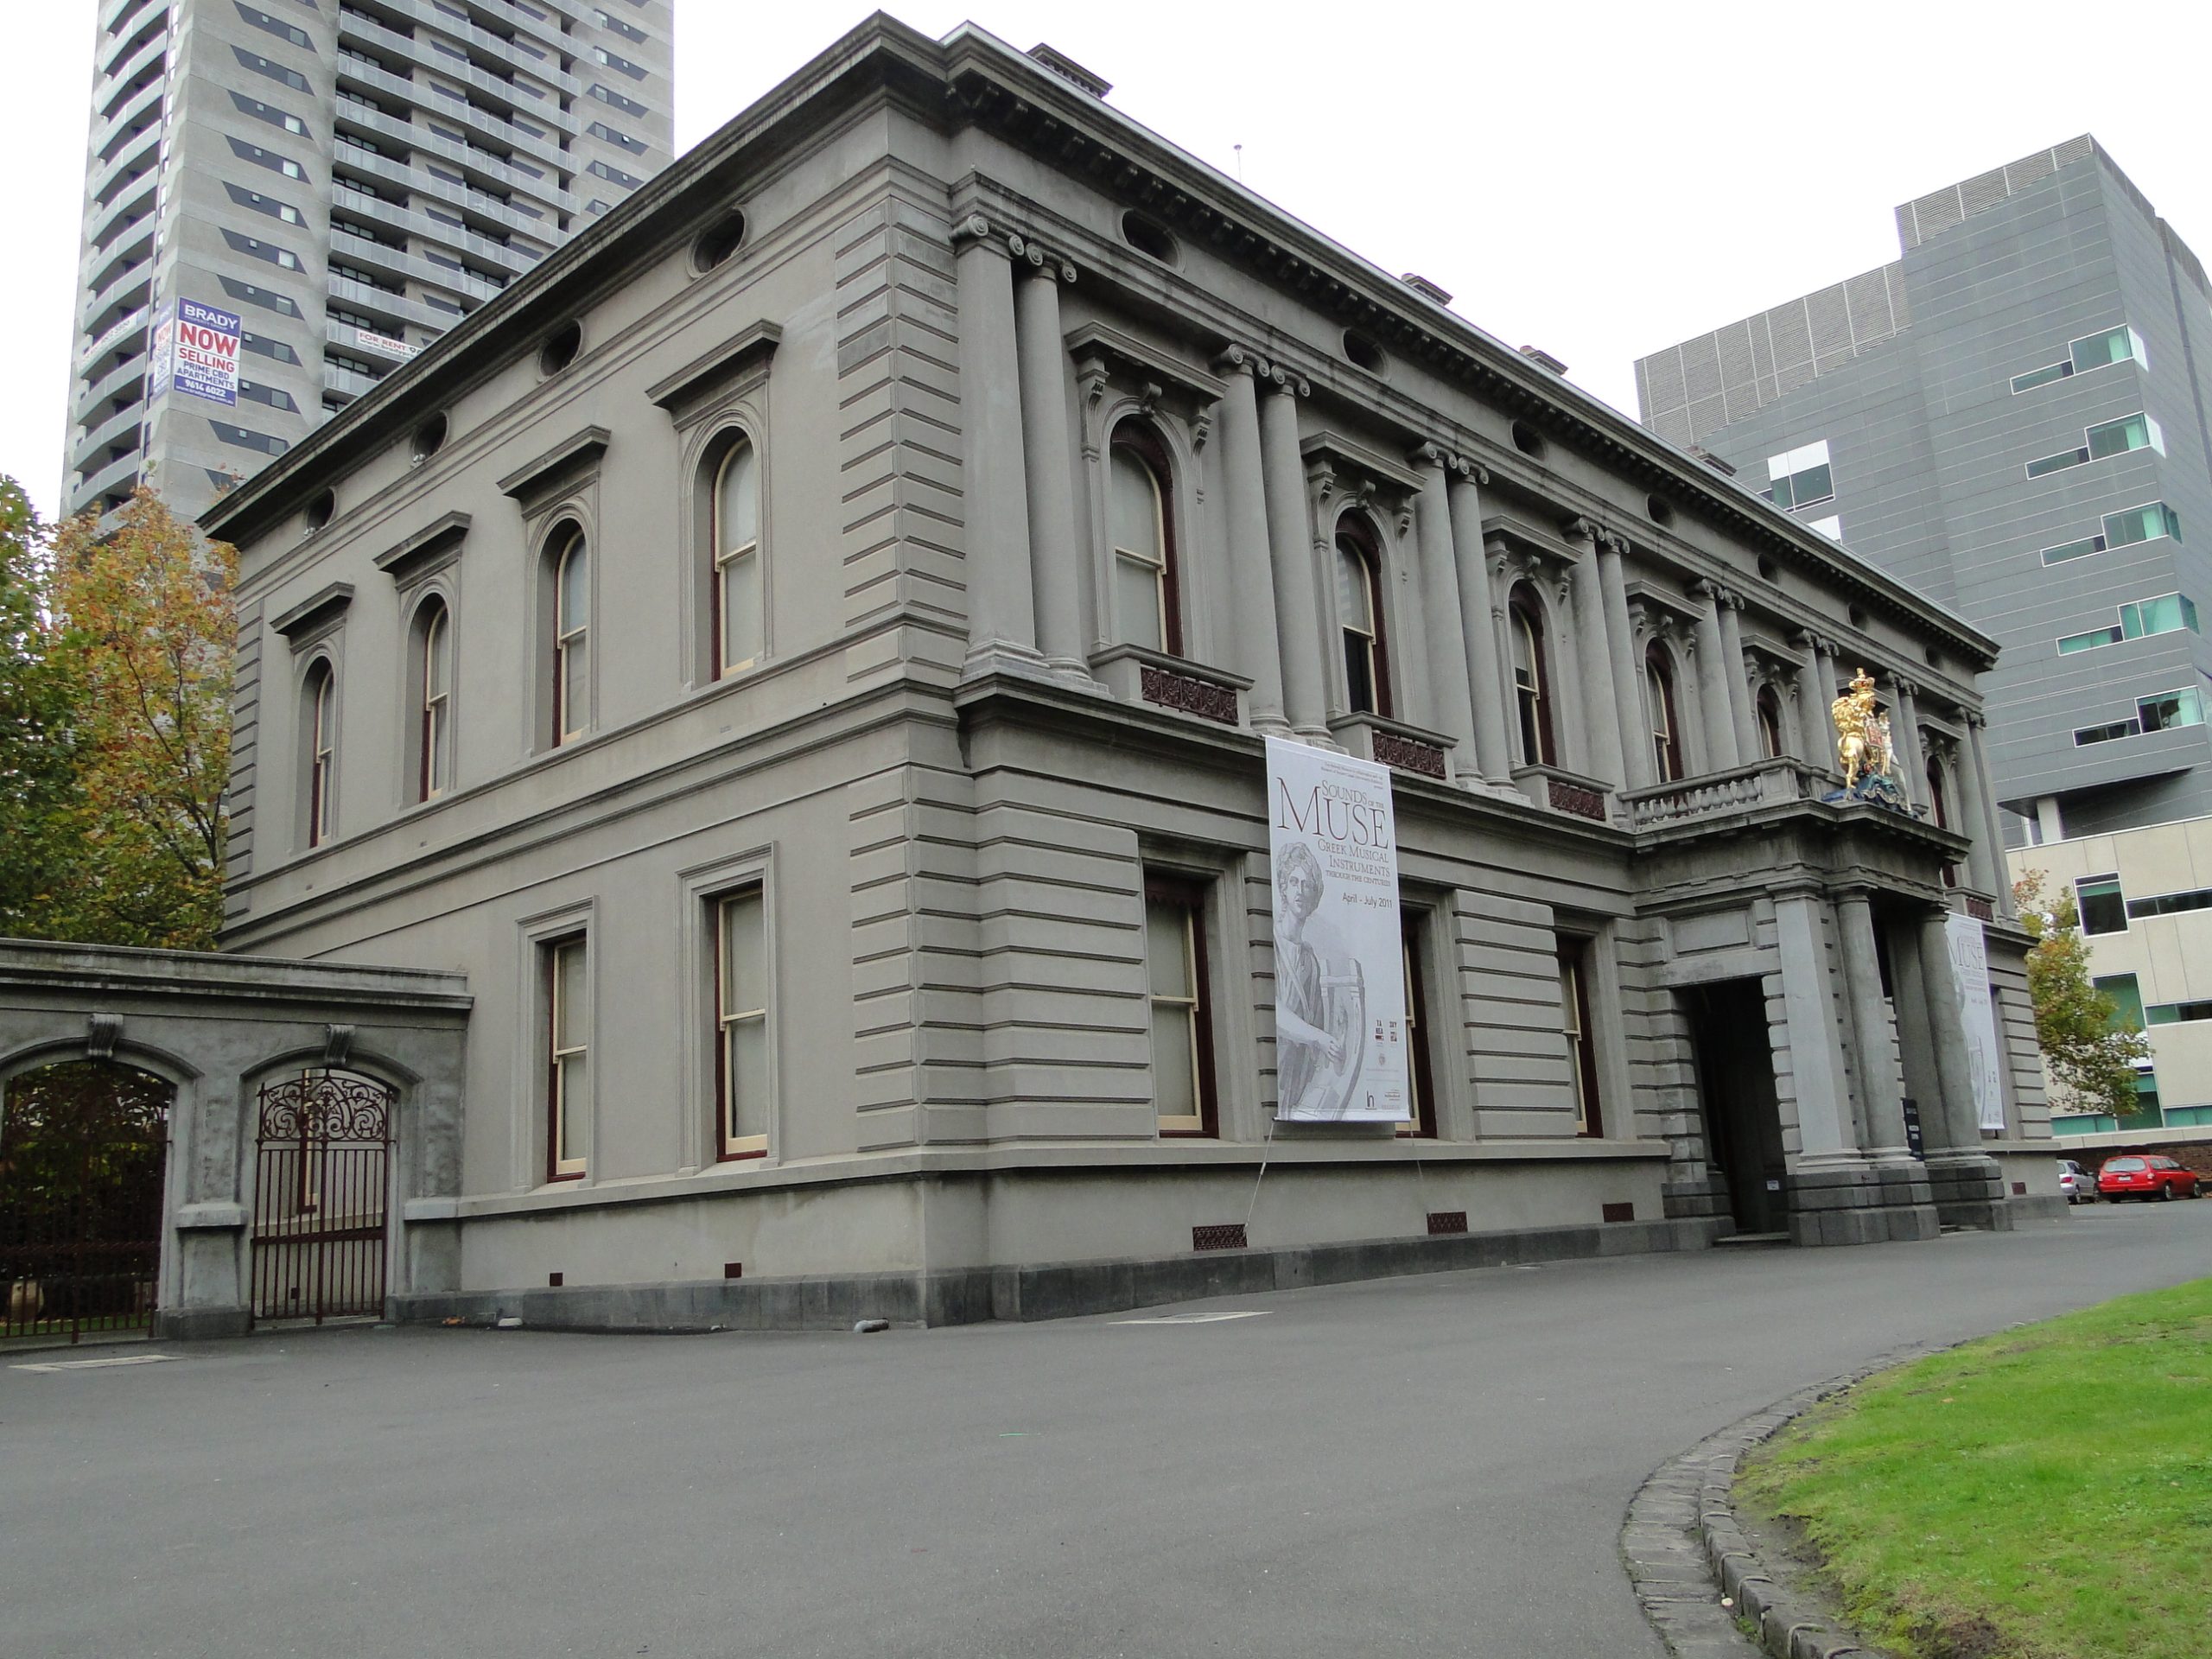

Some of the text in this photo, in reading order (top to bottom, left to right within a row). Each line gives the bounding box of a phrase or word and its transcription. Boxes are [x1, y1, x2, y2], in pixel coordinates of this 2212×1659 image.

[185, 304, 238, 329] BRADY
[181, 322, 238, 357] NOW
[359, 333, 378, 342] FOR
[382, 340, 406, 351] RENT
[179, 348, 235, 372] SELLING
[183, 361, 211, 374] PRIME
[213, 369, 229, 380] CBD
[177, 368, 235, 389] APARTMENTS
[185, 379, 226, 397] 9614 6022
[1322, 780, 1367, 804] SOUNDS
[1276, 777, 1389, 849] MUSE
[1318, 839, 1389, 863] GREEK MUSICAL
[1329, 855, 1390, 877] INSTRUMENTS
[1342, 892, 1357, 906] April
[1364, 895, 1377, 908] July
[1378, 898, 1392, 908] 2011
